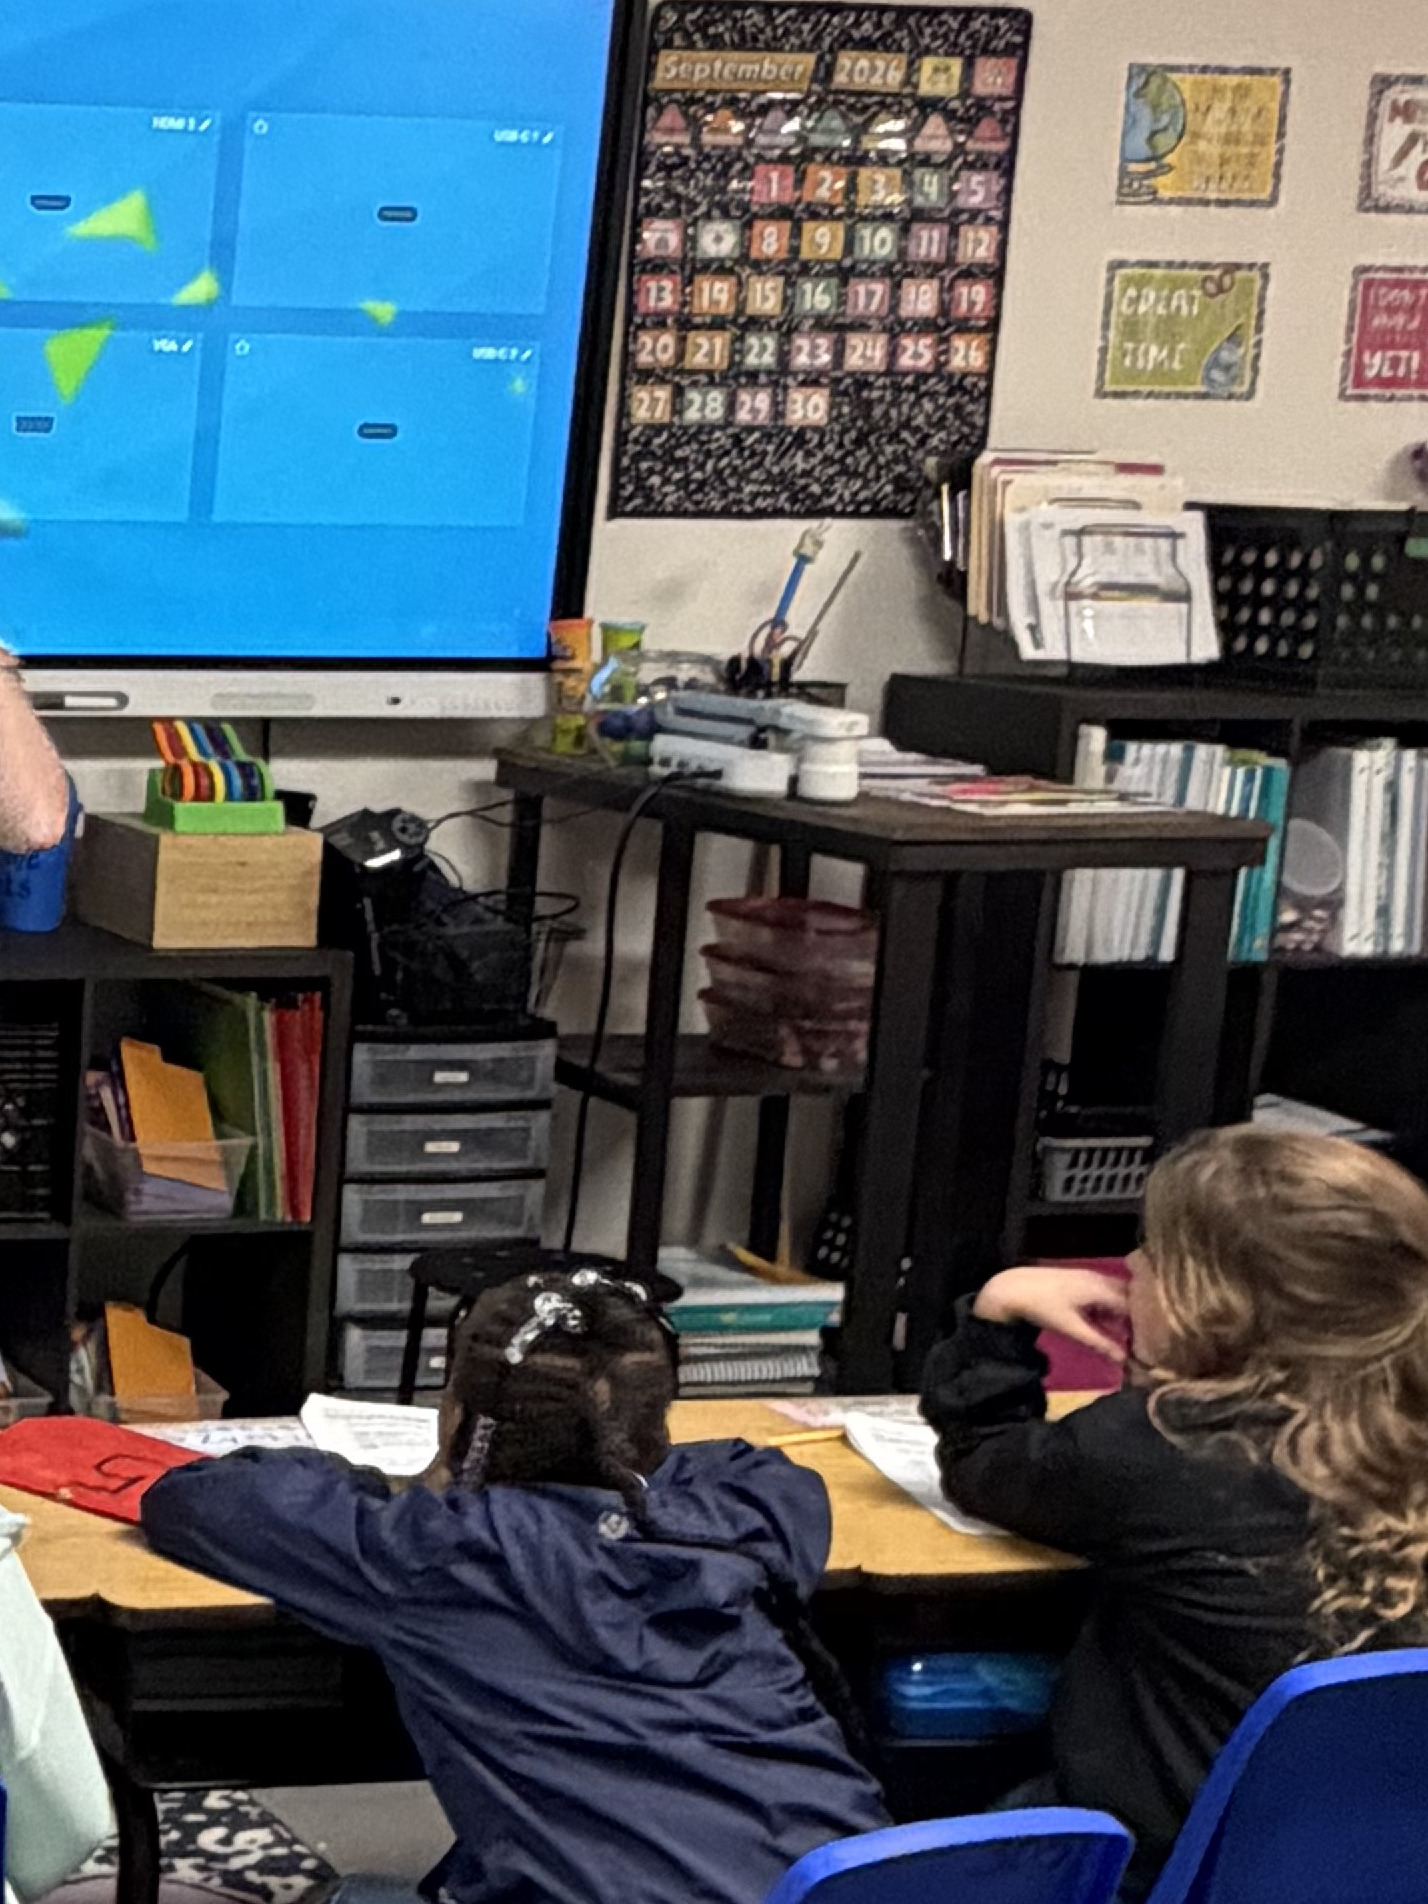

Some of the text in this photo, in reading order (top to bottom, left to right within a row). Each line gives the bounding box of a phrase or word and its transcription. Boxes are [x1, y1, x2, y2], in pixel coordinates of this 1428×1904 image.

[663, 54, 902, 84] September 2026
[762, 225, 989, 254] 8 9 10 11 12
[645, 279, 674, 308] 13
[752, 280, 777, 307] 15
[802, 282, 831, 308] 16
[855, 282, 883, 310] 17
[958, 285, 984, 312] 19
[641, 334, 676, 361] 20
[692, 336, 724, 362] 21
[744, 336, 774, 363] 22
[796, 336, 830, 363] 23
[848, 335, 883, 363] 24
[899, 336, 933, 364] 25
[636, 391, 826, 421] 27 28 29 30
